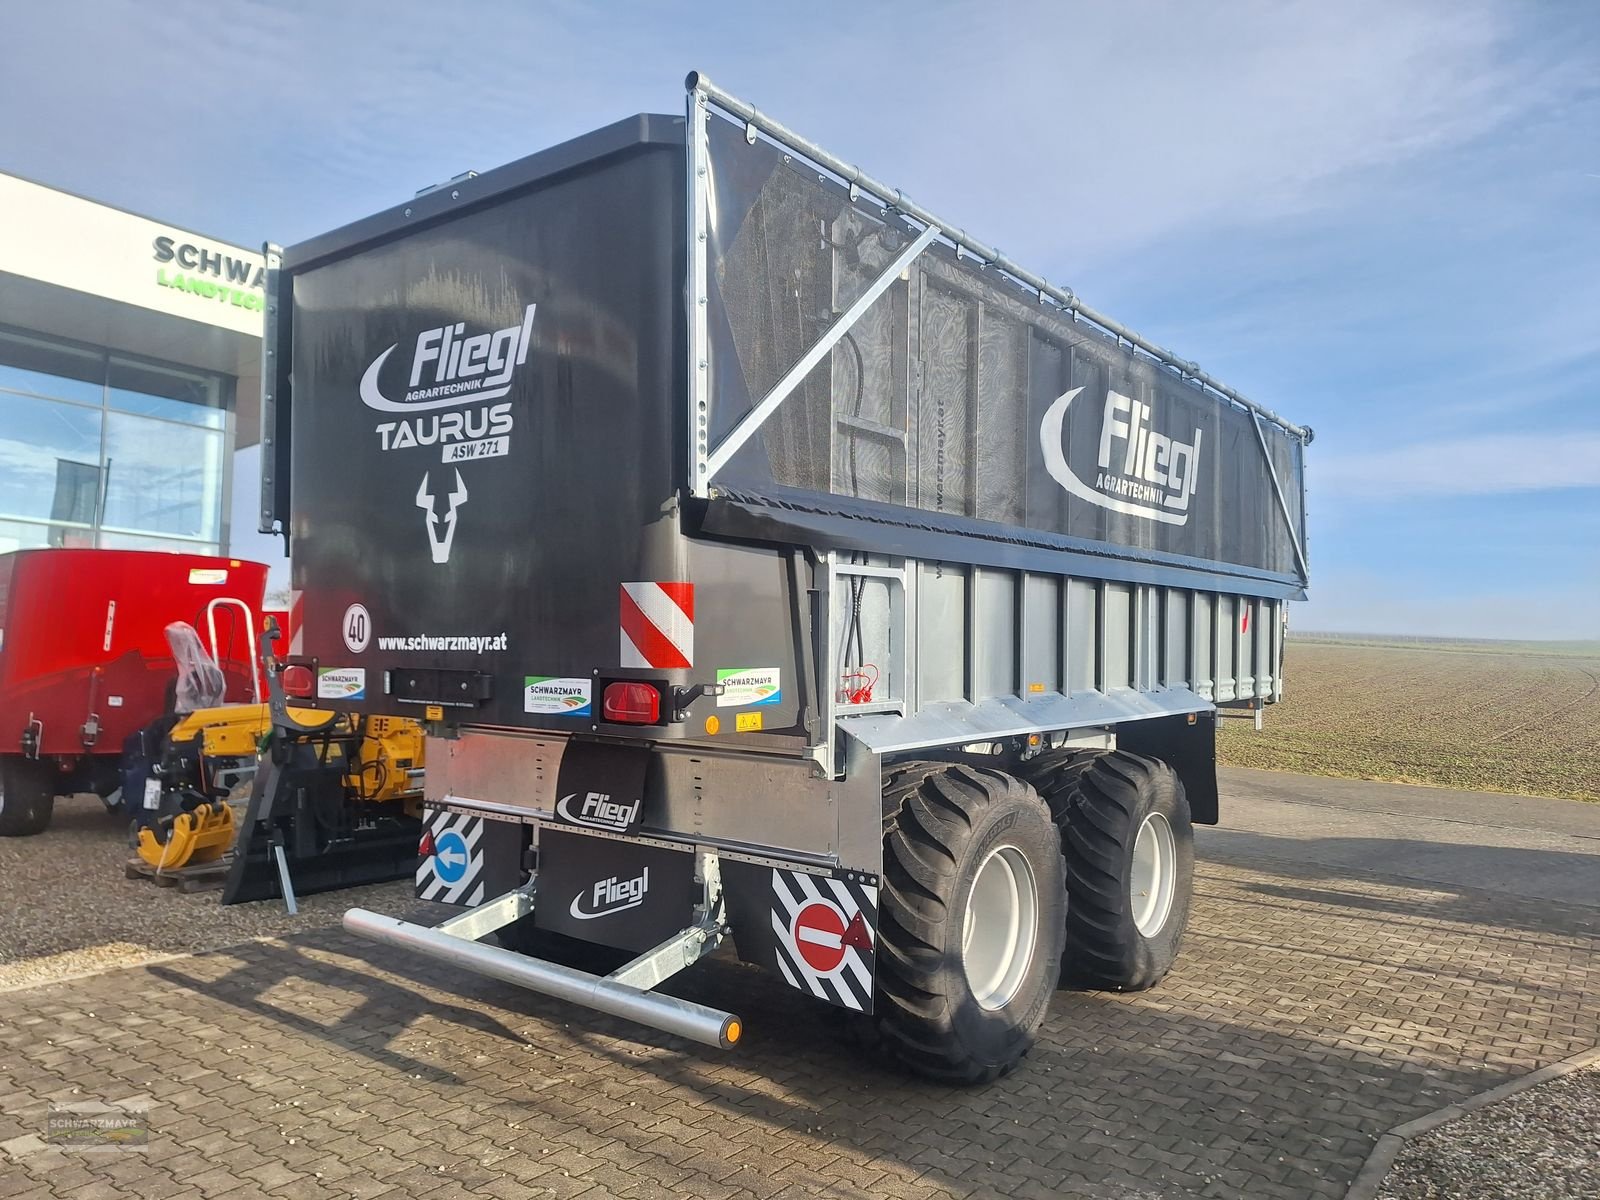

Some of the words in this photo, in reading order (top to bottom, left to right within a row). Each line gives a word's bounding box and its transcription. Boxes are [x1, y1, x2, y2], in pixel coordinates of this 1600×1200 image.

[409, 303, 536, 388] Fliegl
[405, 379, 483, 402] AGRARTECHNIK
[375, 402, 514, 451] TAURUS
[451, 444, 477, 460] ASW
[478, 440, 499, 456] 271
[1098, 390, 1203, 511] Fliegl
[1096, 473, 1165, 506] AGRARTECHNIK
[348, 613, 365, 643] 40
[378, 632, 507, 655] www.schwarzmayr.at
[530, 686, 582, 695] SCHWARZMAYR
[723, 677, 772, 686] SCHWARZMAYR
[581, 792, 640, 827] Fliegl
[593, 866, 649, 908] Fliegl
